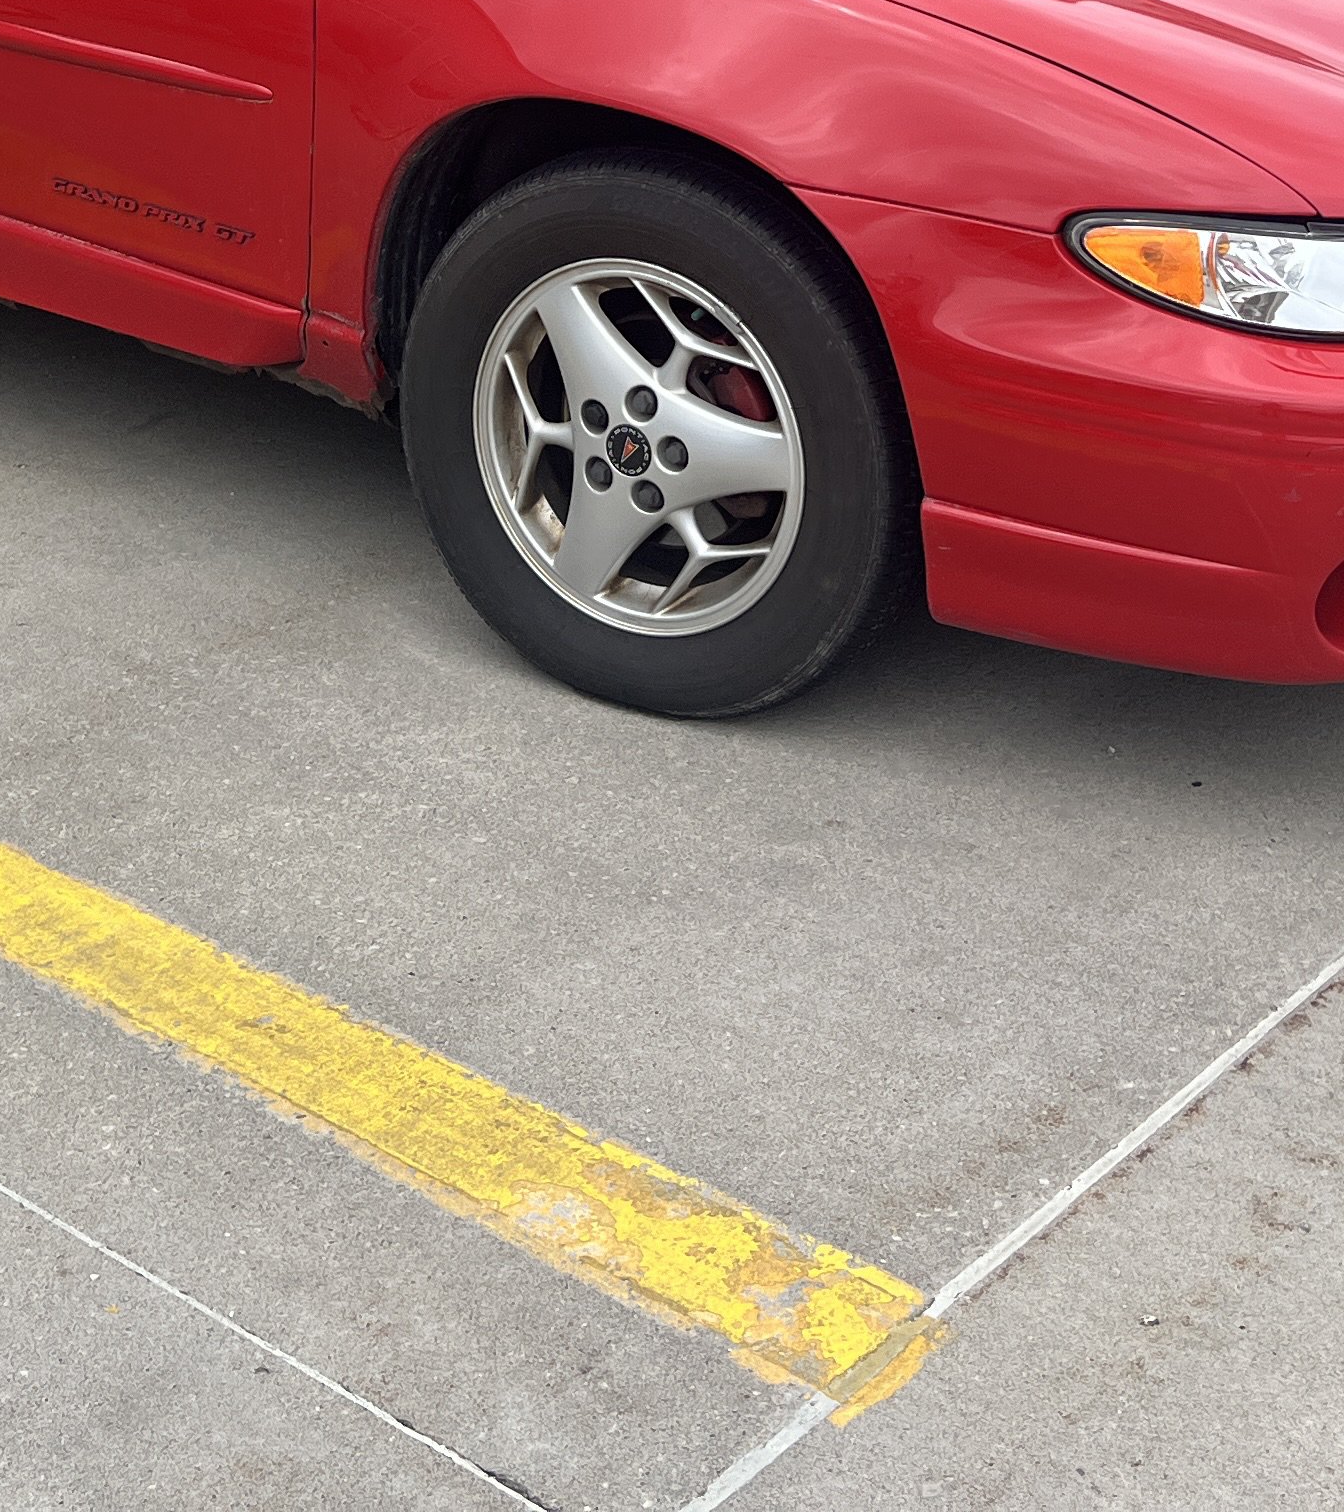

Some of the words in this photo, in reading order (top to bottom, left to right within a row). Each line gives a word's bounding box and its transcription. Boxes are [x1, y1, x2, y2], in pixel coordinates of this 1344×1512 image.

[51, 176, 140, 214] GRAND
[140, 201, 208, 234] PRIX
[214, 222, 256, 246] GT
